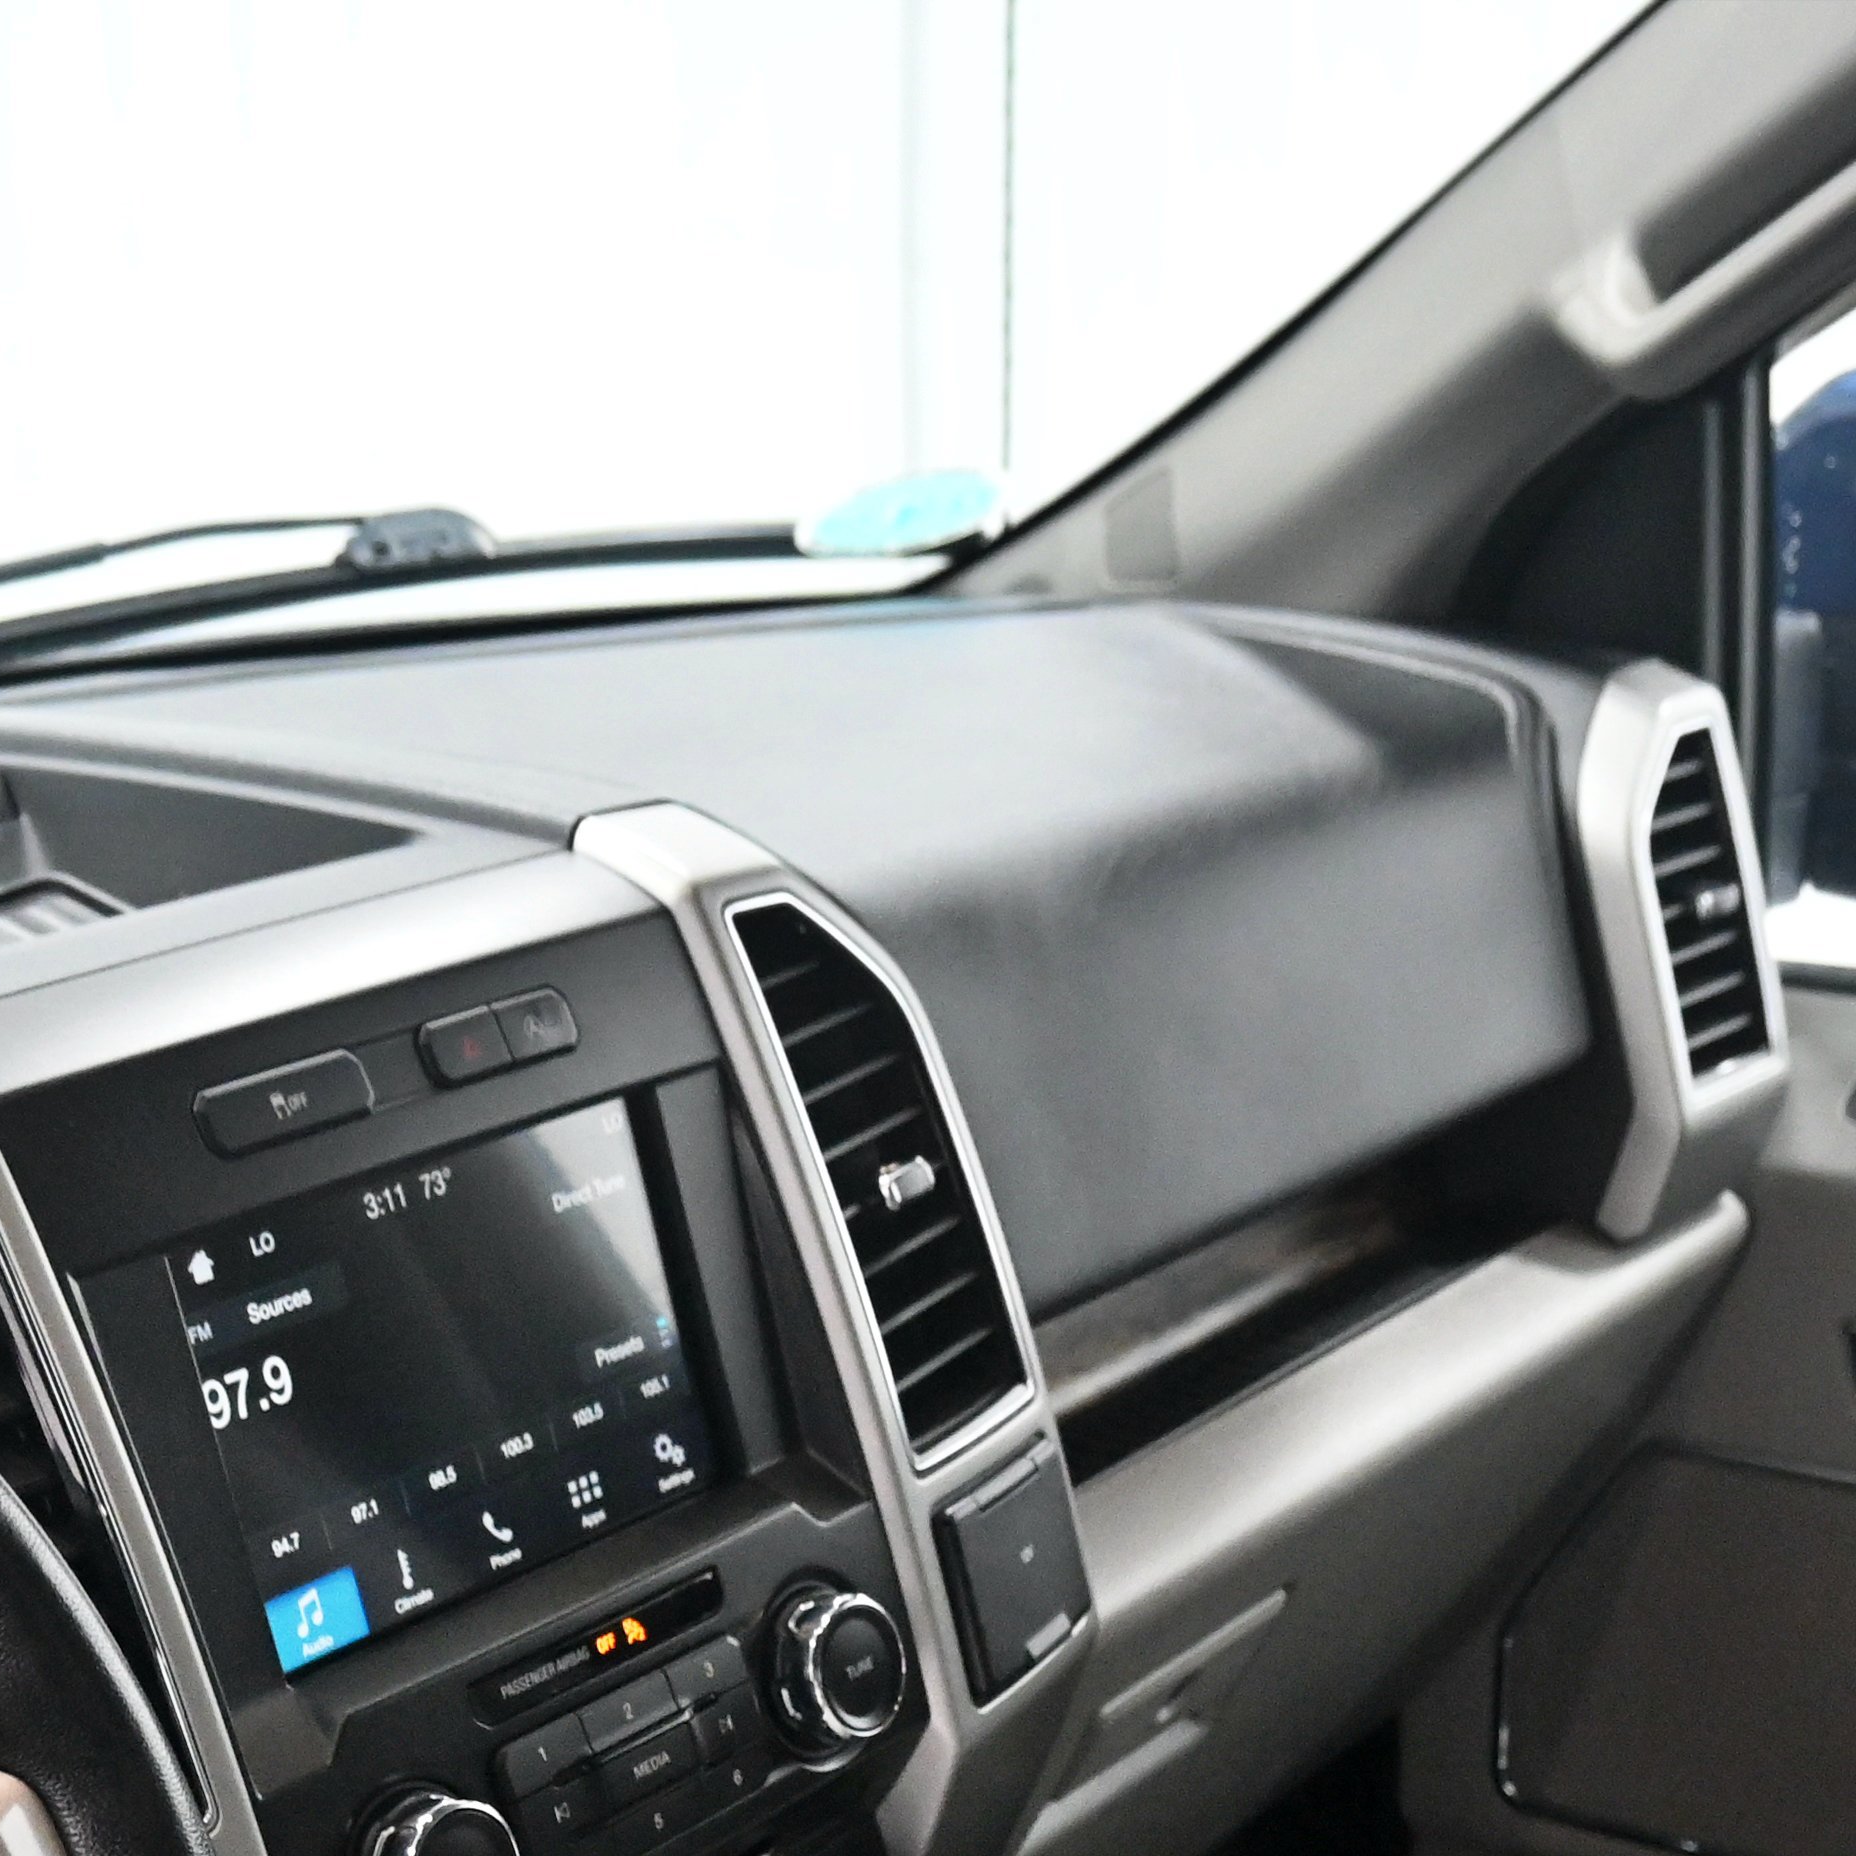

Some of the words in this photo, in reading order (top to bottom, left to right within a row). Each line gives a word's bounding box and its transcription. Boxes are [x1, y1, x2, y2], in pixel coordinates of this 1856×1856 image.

[362, 1183, 408, 1220] 3:11
[249, 1230, 276, 1257] LO
[246, 1287, 313, 1326] Sources
[187, 1321, 214, 1345] FM
[594, 1335, 645, 1368] Presets
[201, 1355, 294, 1430] 97.9
[500, 1432, 534, 1459] 100.3
[350, 1498, 380, 1524] 97.1
[271, 1531, 300, 1558] 94.7
[489, 1547, 523, 1571] Phone
[394, 1588, 434, 1615] Climate
[302, 1634, 334, 1659] Audio
[499, 1660, 557, 1700] PASSENGER
[595, 1631, 617, 1656] OFF
[703, 1661, 716, 1679] 3
[622, 1702, 634, 1721] 2
[537, 1746, 548, 1763] 1
[632, 1749, 672, 1781] MEDIA
